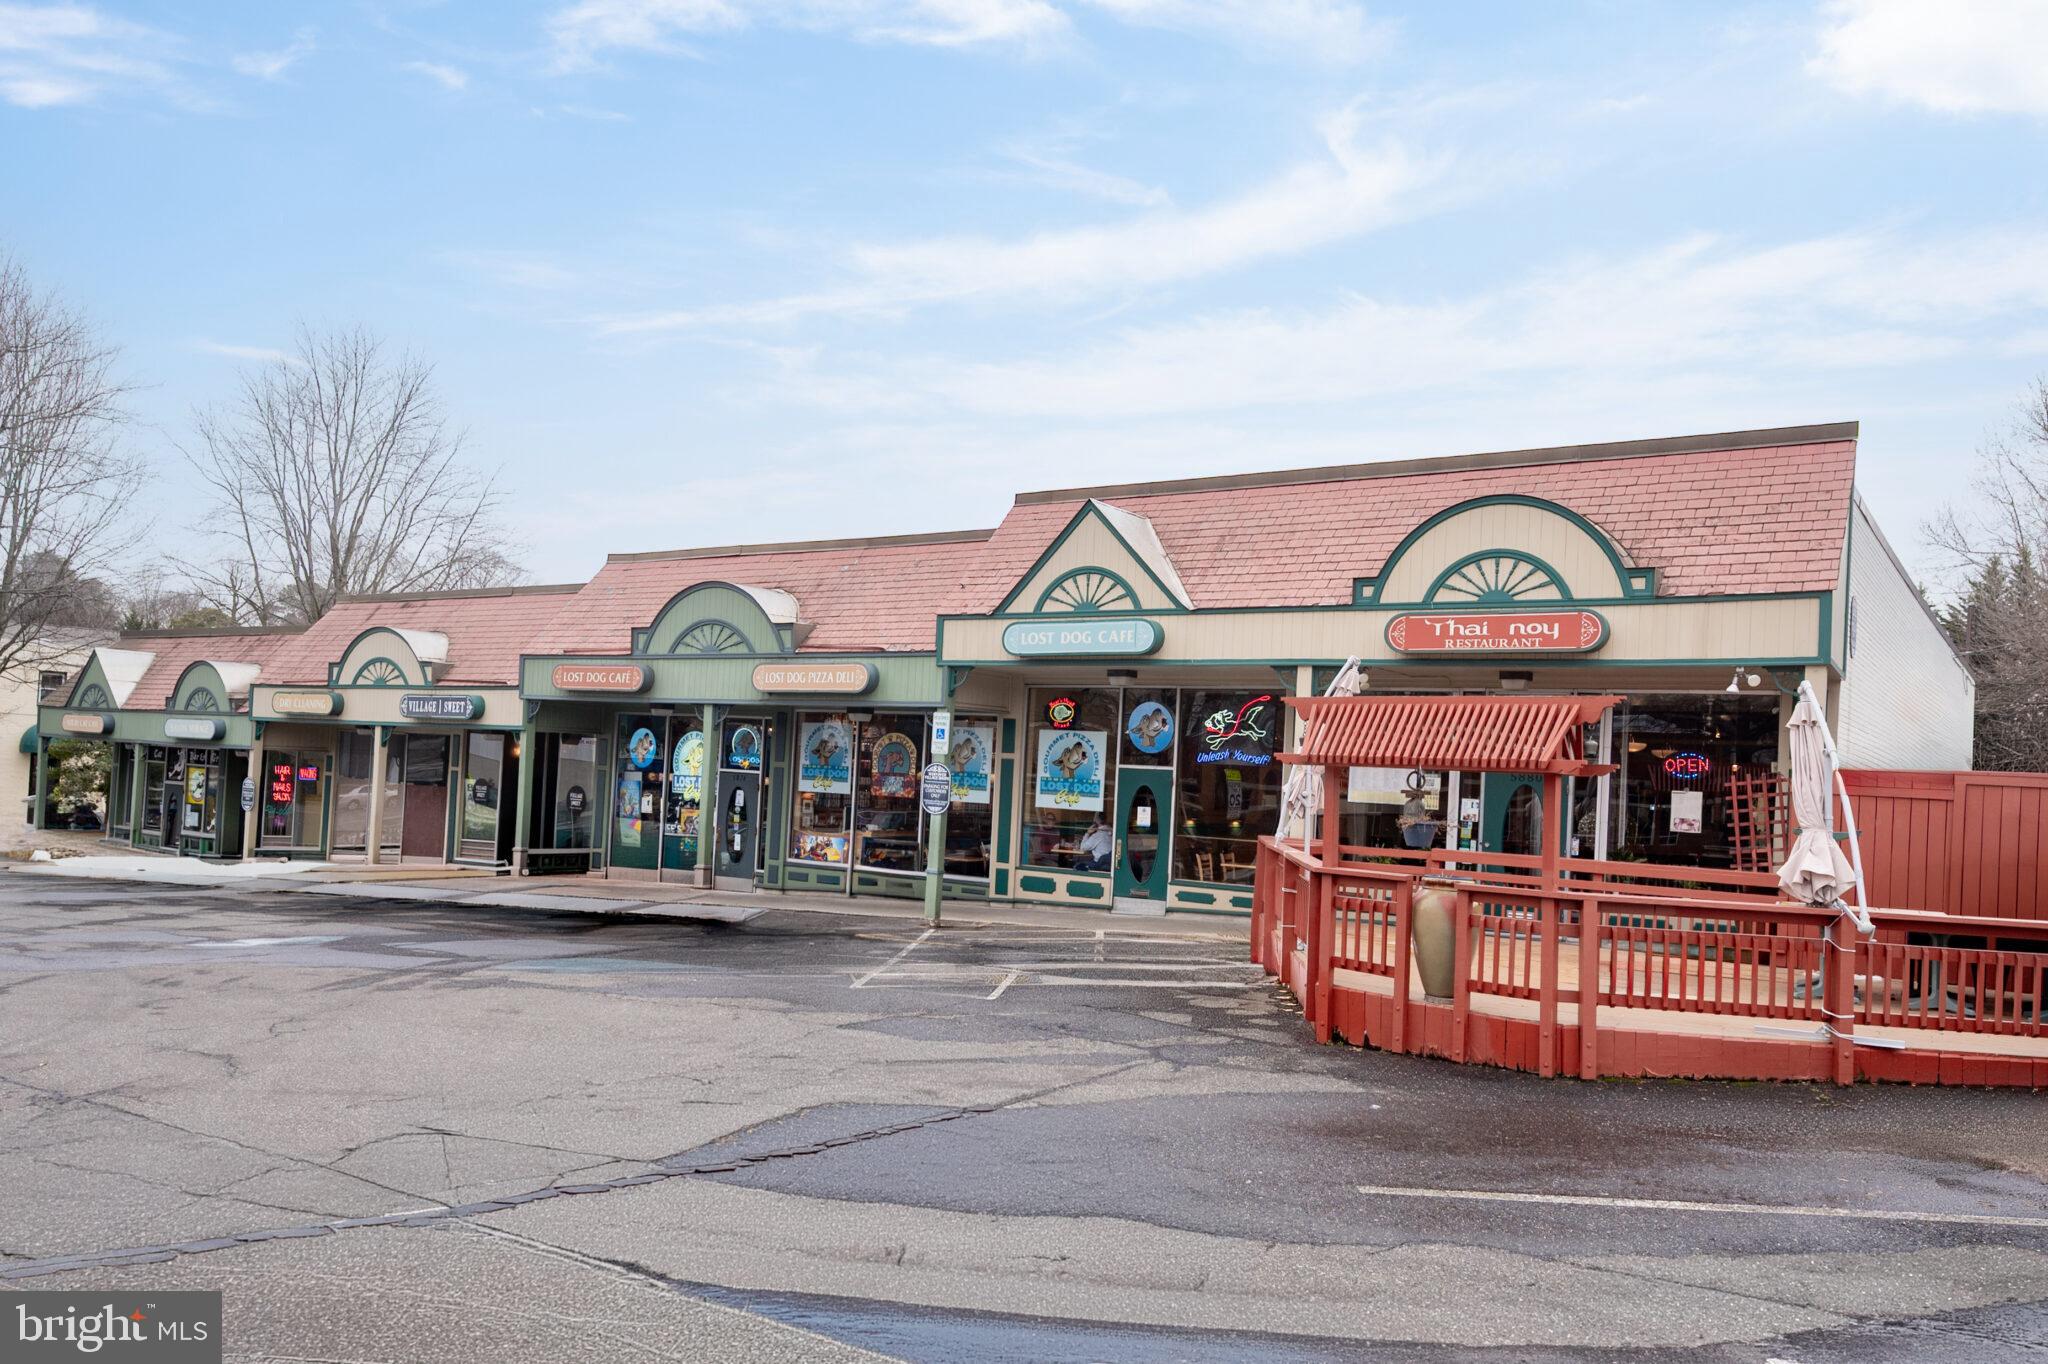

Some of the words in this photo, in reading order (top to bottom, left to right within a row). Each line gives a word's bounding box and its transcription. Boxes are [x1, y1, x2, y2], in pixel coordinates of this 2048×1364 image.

[1425, 618, 1489, 636] Thai
[1508, 622, 1560, 640] noy
[1020, 632, 1056, 645] LOST
[1060, 631, 1092, 644] DOG
[1098, 630, 1135, 644] CAFE
[1444, 637, 1543, 649] RESTAURANT
[563, 672, 584, 682] LOST
[586, 672, 606, 683] DOG
[608, 670, 632, 684] CAFÉ
[765, 672, 784, 683] LOST
[787, 672, 806, 684] DOG
[808, 672, 833, 684] PIZZA
[836, 671, 854, 683] DELI
[408, 700, 436, 713] VILLAGE
[443, 701, 465, 713] SWEET
[1043, 731, 1071, 774] GOURMET
[1072, 732, 1095, 751] PIZZA
[1092, 751, 1100, 777] DELI
[1196, 749, 1230, 763] Unleash
[1665, 758, 1709, 772] OPEN
[674, 775, 696, 788] LOST
[1040, 782, 1071, 792] LOST
[1073, 783, 1100, 794] DOG
